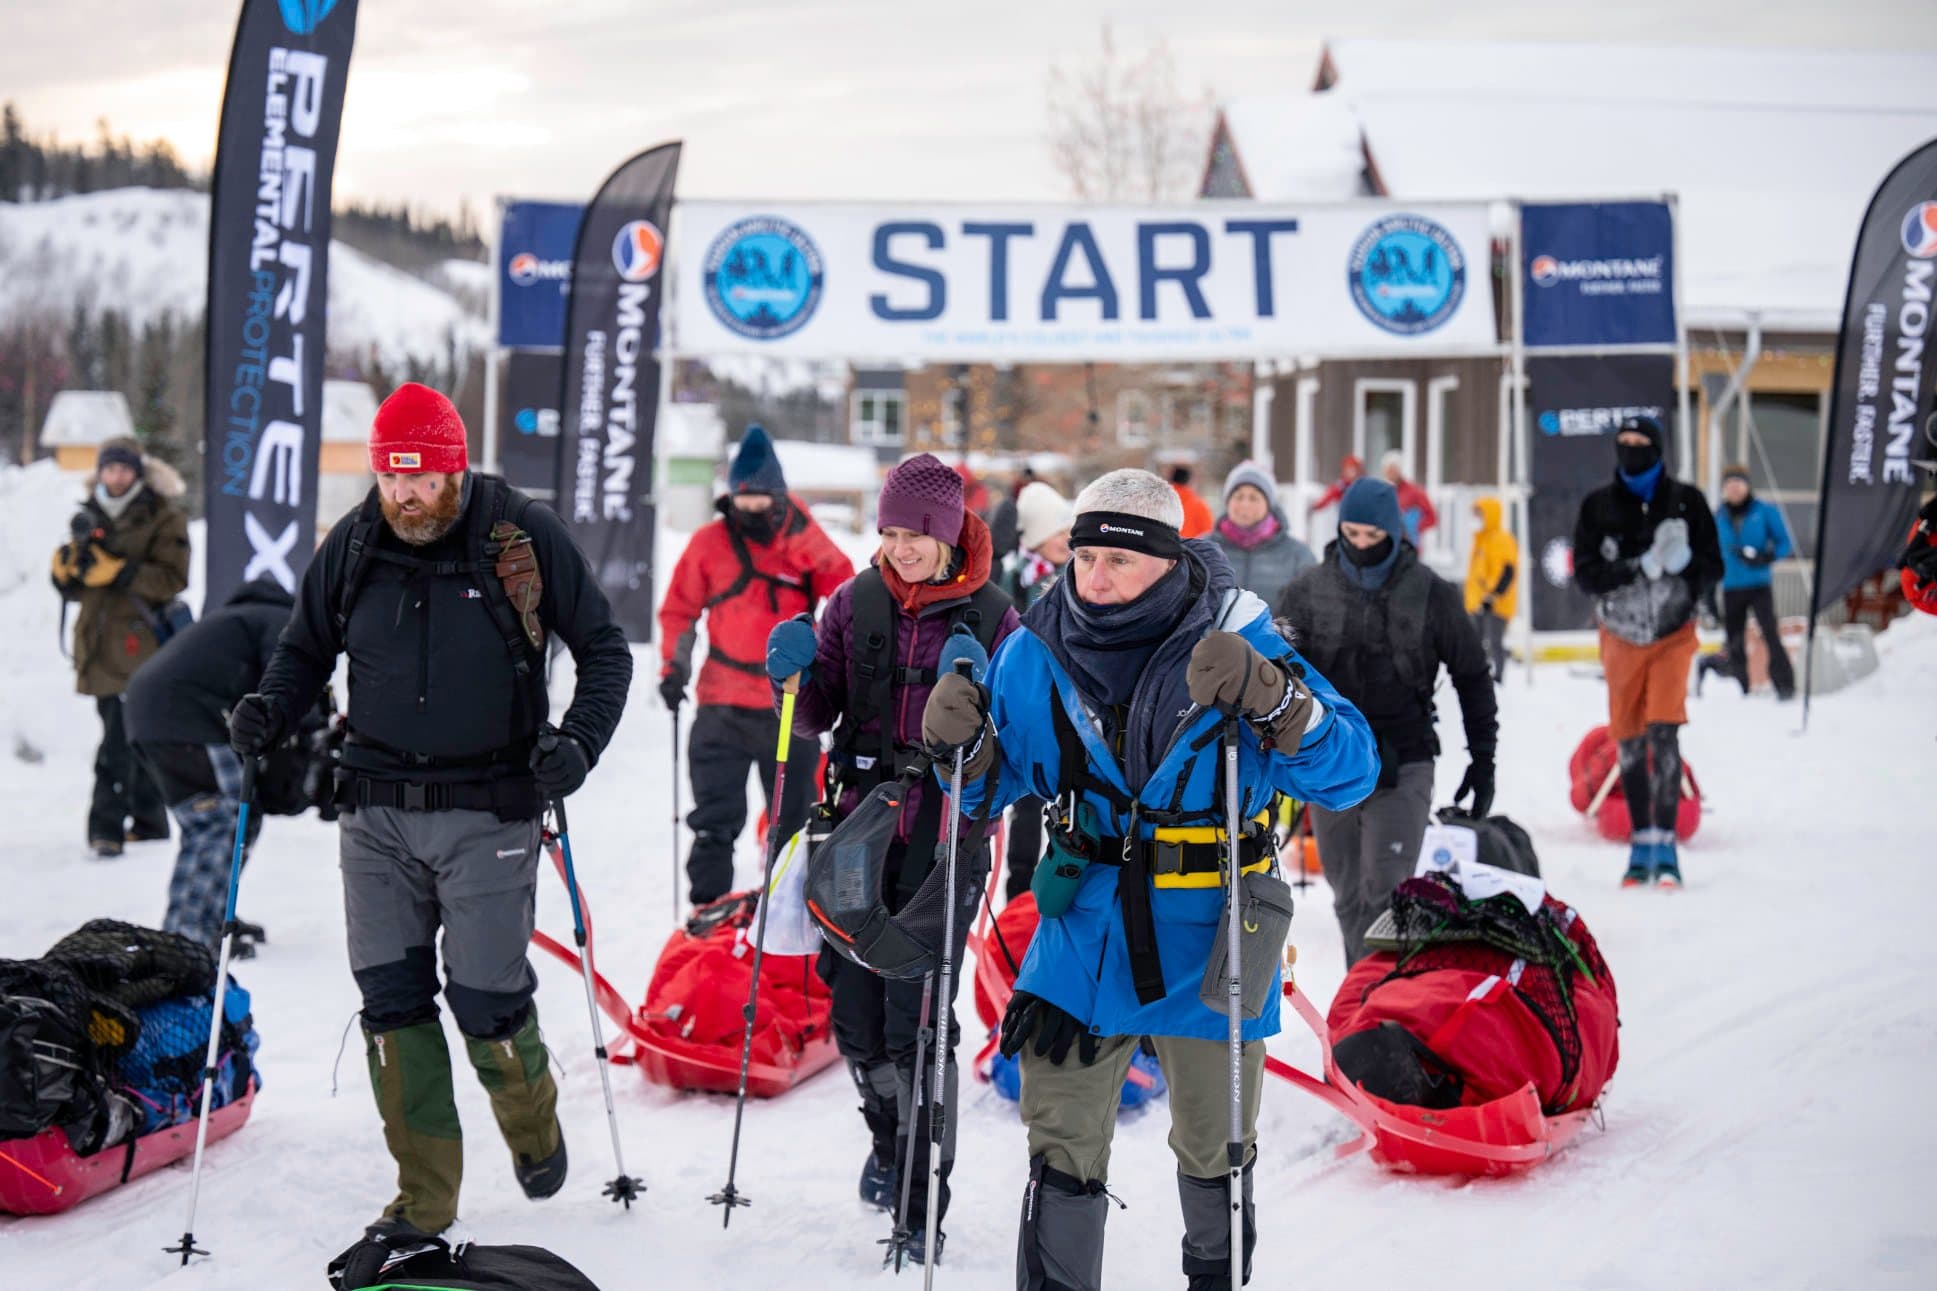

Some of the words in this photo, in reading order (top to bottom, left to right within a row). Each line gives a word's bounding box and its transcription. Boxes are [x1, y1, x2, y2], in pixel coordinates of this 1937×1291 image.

[250, 47, 288, 271] ELEMENTAL
[869, 219, 1298, 322] START
[221, 271, 276, 497] PROTECTION
[245, 50, 328, 595] PERTEX
[602, 282, 651, 521] MONTANE
[1883, 259, 1934, 485] MONTANE
[1108, 525, 1144, 537] MONTANE
